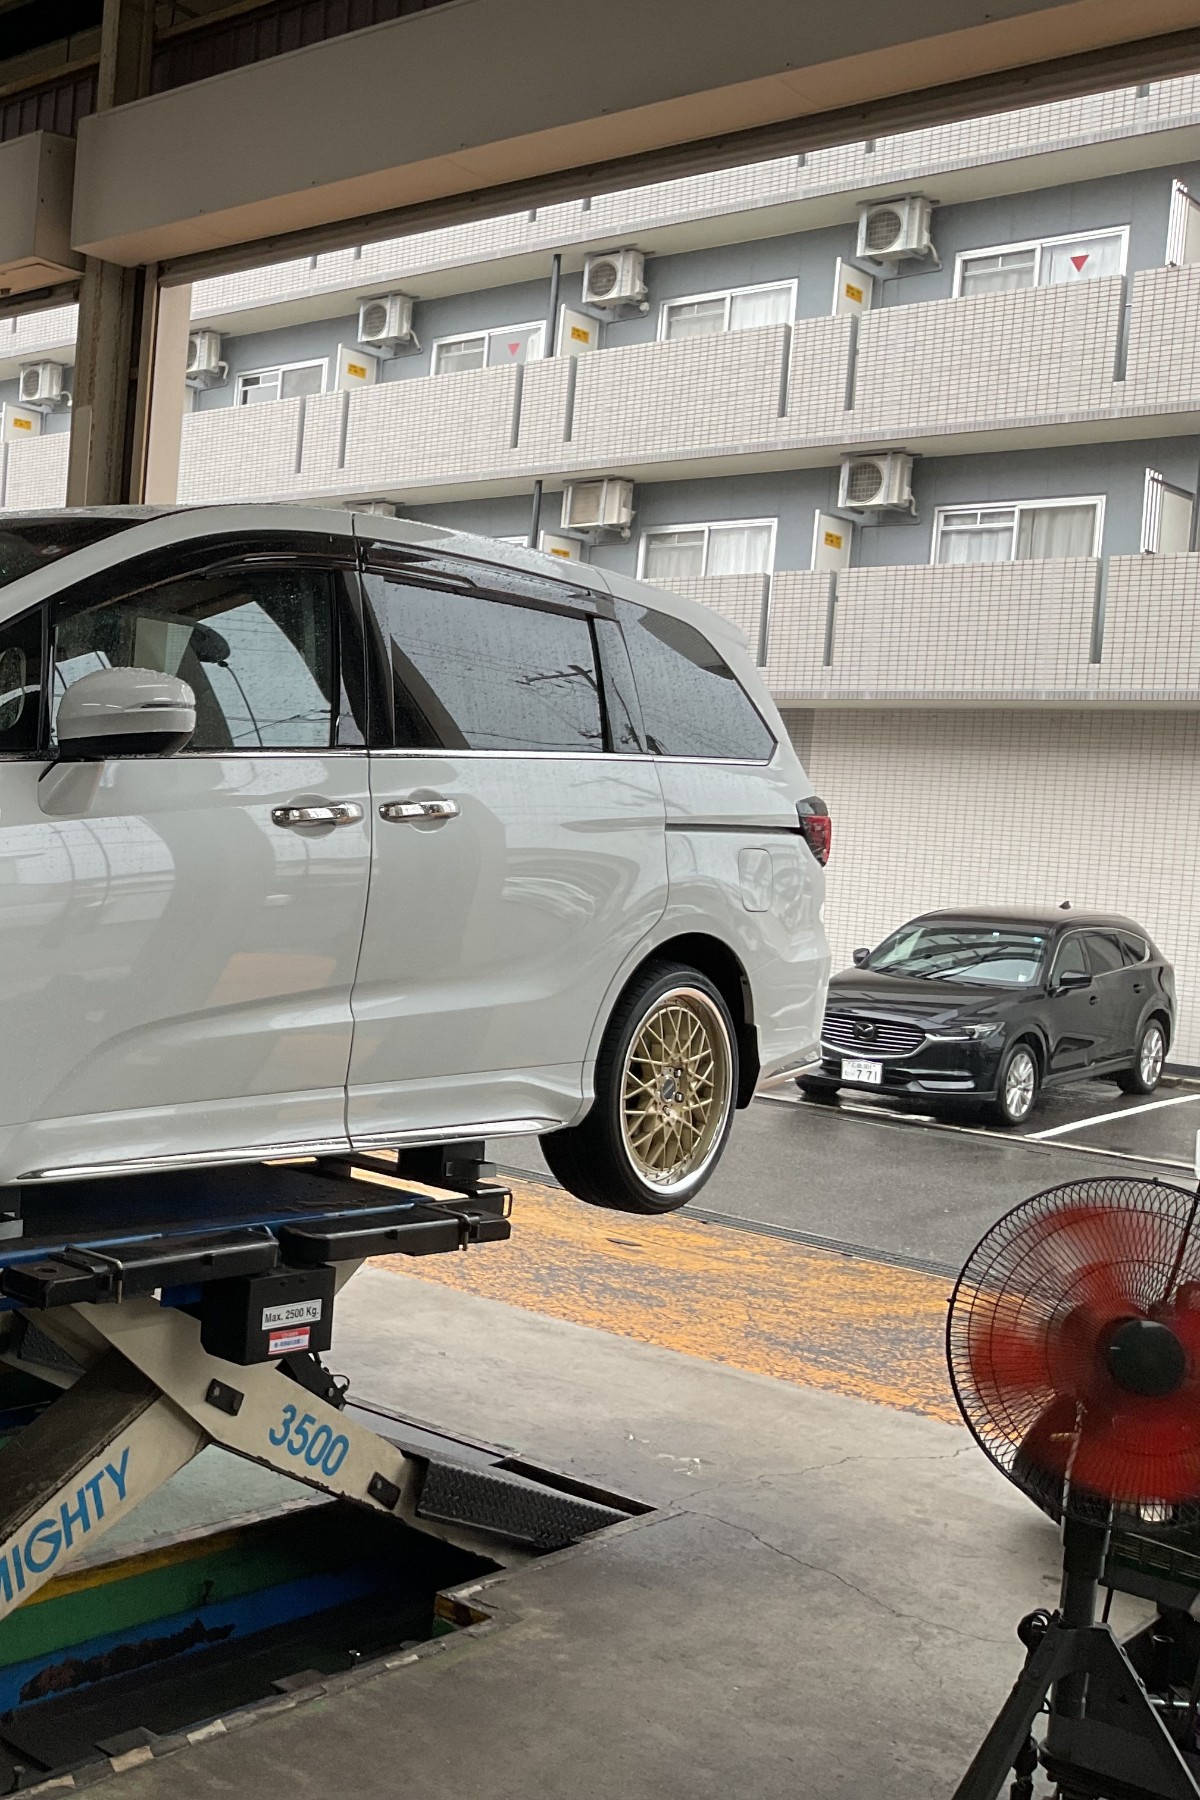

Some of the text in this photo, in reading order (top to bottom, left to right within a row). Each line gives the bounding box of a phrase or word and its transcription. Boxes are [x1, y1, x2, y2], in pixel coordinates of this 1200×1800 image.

[264, 1312, 284, 1324] Max.
[285, 1307, 304, 1320] 2500
[268, 1403, 350, 1477] 3500
